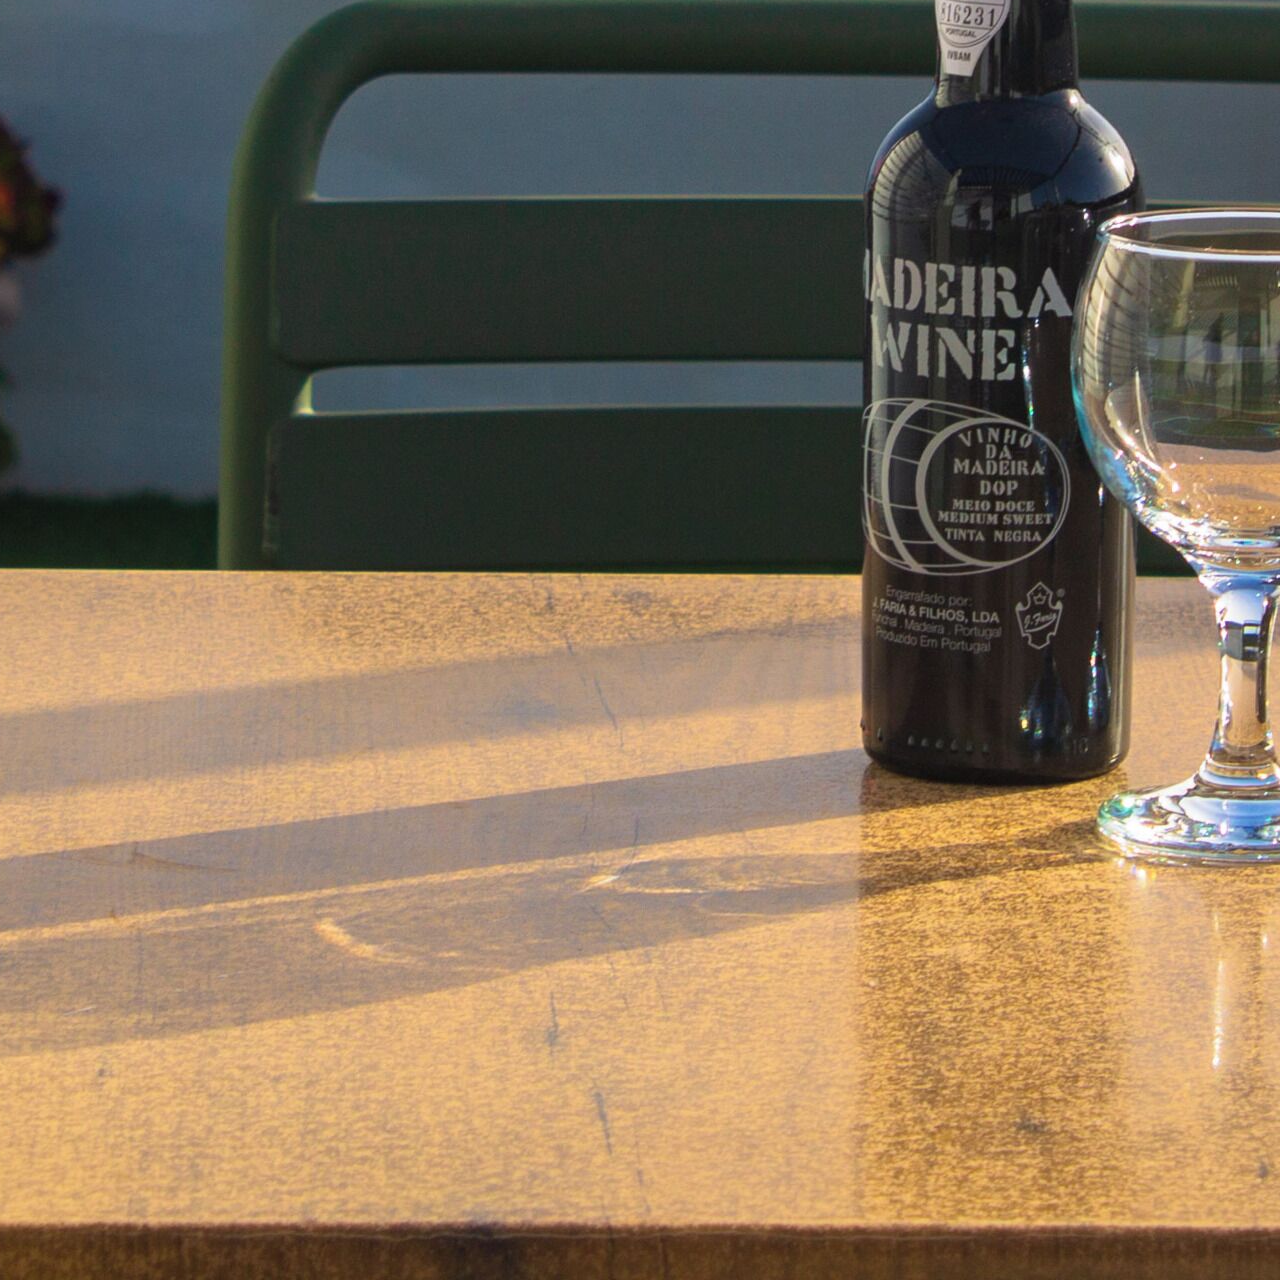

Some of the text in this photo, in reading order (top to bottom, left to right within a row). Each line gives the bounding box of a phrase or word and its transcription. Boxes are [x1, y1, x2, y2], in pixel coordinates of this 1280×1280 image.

[863, 248, 1072, 318] ADEIRA
[871, 315, 1015, 380] WINE
[958, 427, 1032, 448] VINHO
[986, 444, 1012, 459] DA
[953, 458, 1045, 476] MADEIRA
[980, 480, 1019, 496] DOP
[952, 499, 1035, 512] MEIO DOCE
[937, 511, 1053, 525] MEDIUM SWEET
[944, 528, 1042, 542] TINTA NEGRA
[880, 599, 907, 615] FARIA
[908, 605, 917, 617] &
[919, 606, 969, 624] FILHOS,
[972, 611, 1000, 624] LDA
[954, 624, 1002, 639] Portugal
[920, 635, 938, 648] Em
[941, 637, 991, 654] Portugal
